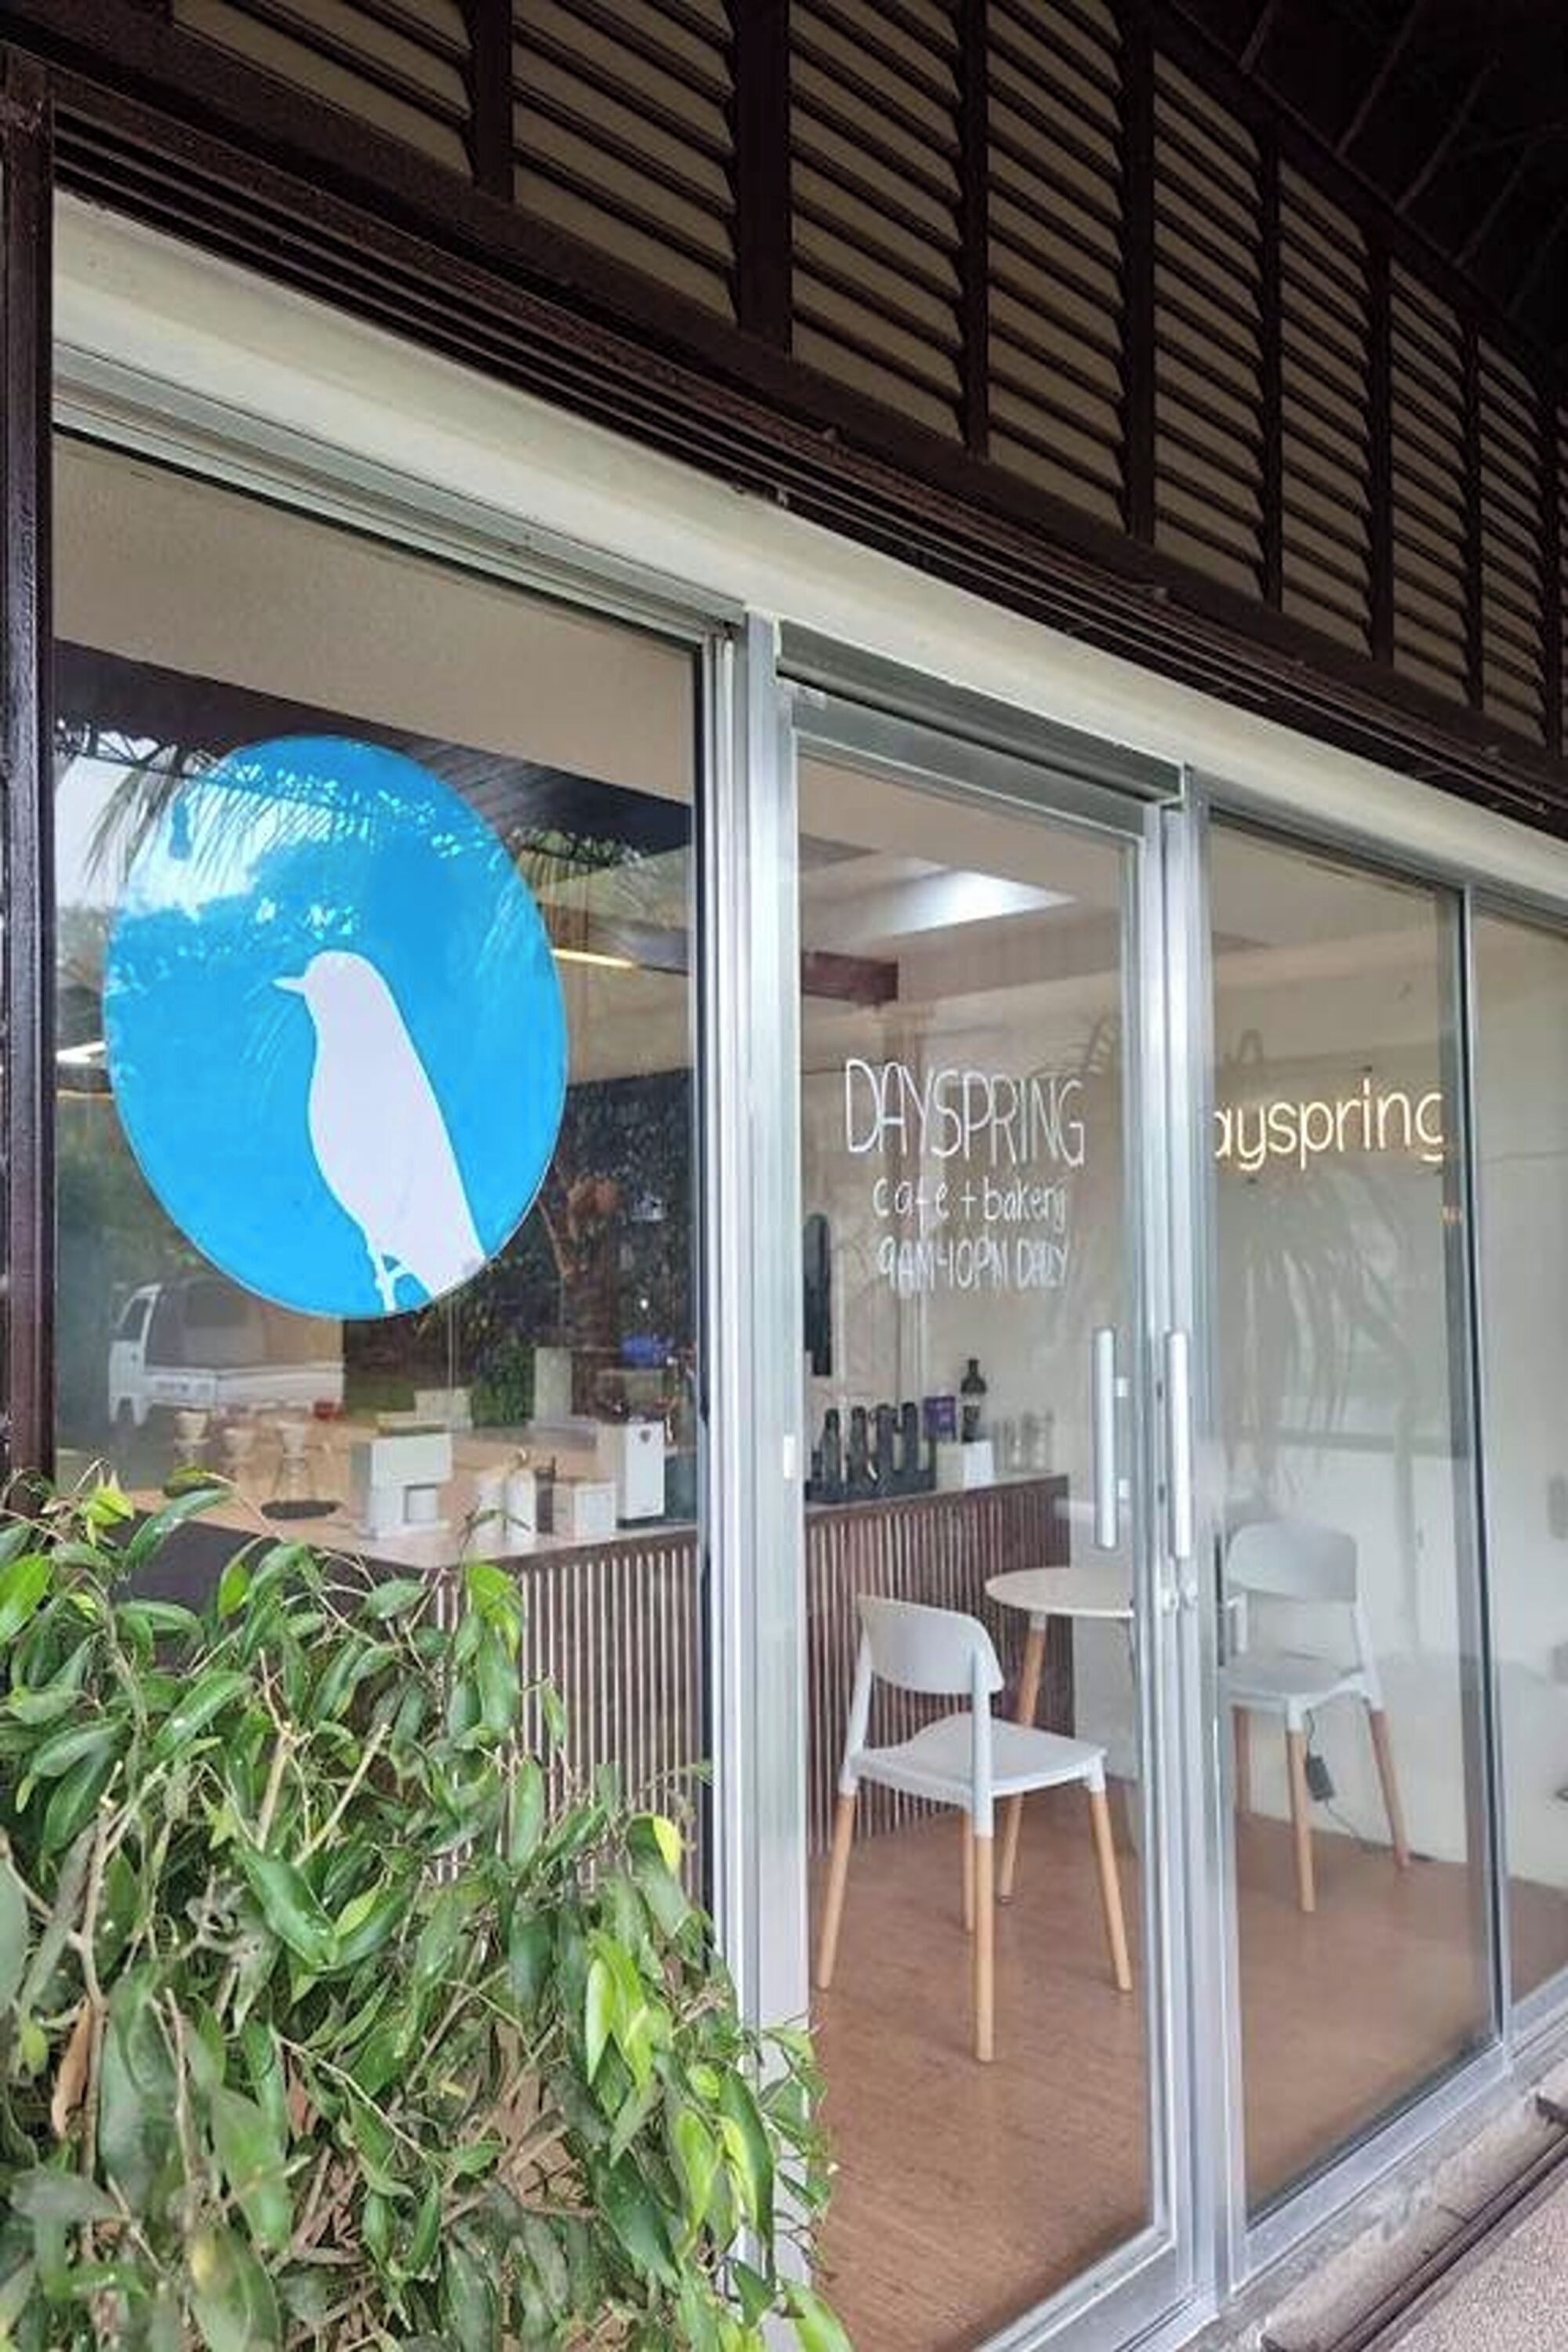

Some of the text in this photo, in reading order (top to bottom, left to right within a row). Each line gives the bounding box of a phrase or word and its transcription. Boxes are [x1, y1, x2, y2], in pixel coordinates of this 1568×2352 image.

[846, 1058, 1085, 1167] DAYSPRING
[960, 1179, 978, 1219] +
[984, 1177, 1066, 1234] bakery
[1018, 1237, 1069, 1288] DAILY
